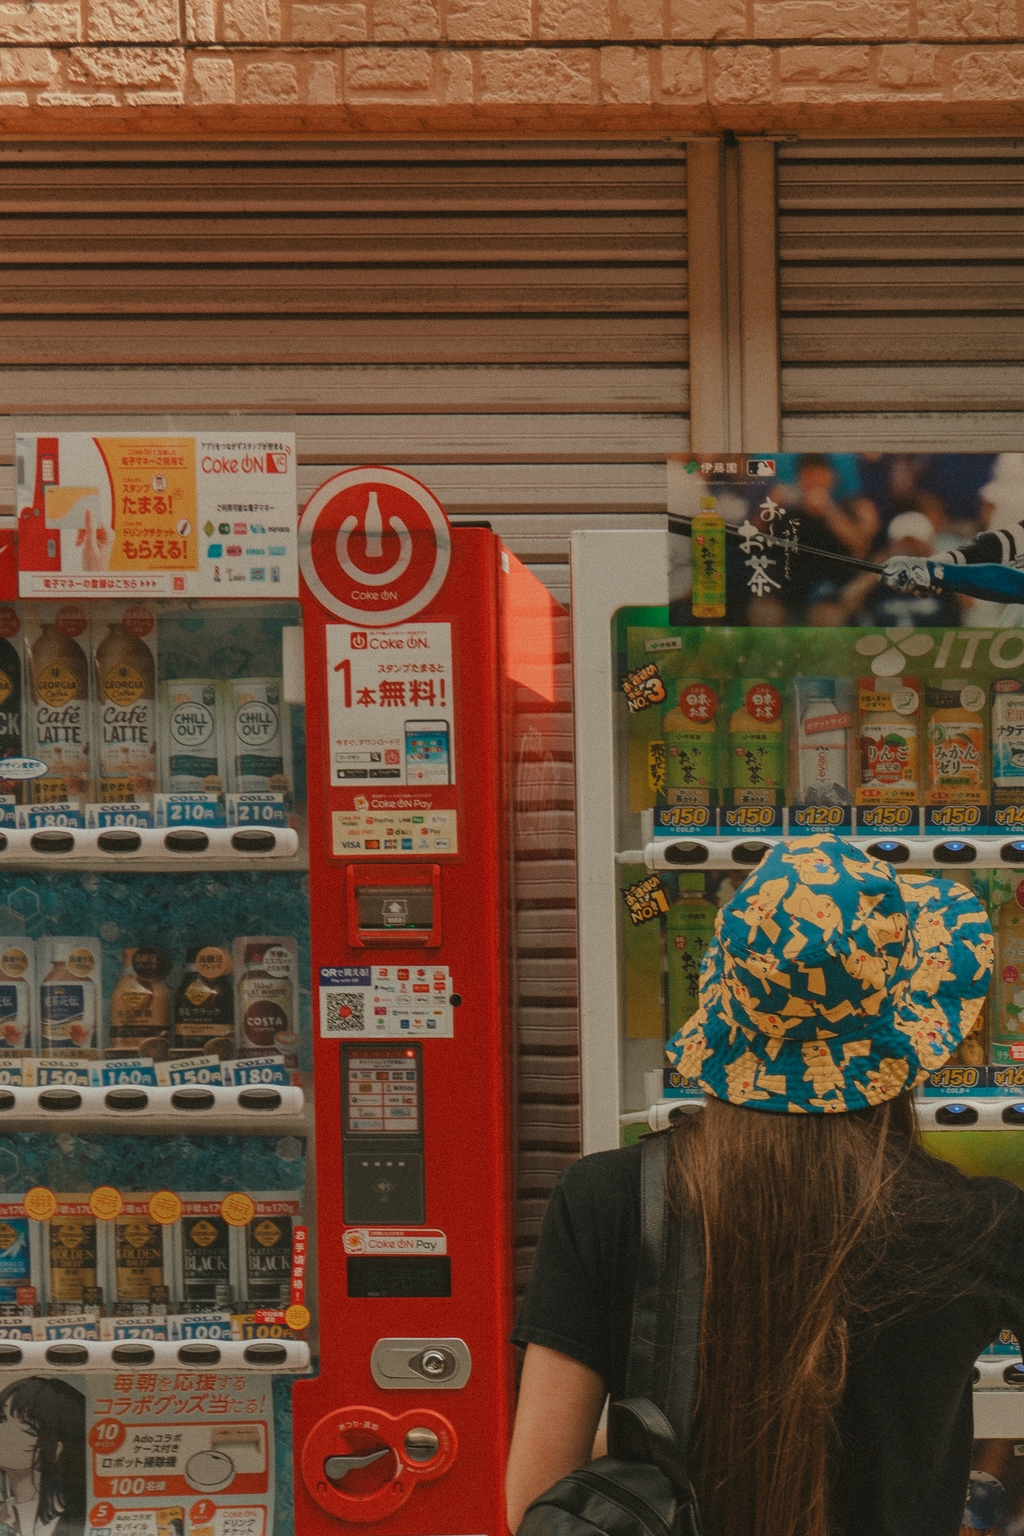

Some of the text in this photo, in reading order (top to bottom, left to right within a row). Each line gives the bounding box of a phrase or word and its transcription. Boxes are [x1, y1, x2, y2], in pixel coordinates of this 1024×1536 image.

[201, 453, 264, 474] Coke ON
[701, 463, 737, 474] 伊藤園
[351, 590, 397, 600] Coke ON
[38, 681, 77, 690] GEORGIA
[104, 681, 144, 690] GEORGIA
[36, 706, 80, 724] Café
[103, 706, 147, 723] Café
[174, 713, 208, 725] CHILL
[239, 713, 273, 725] CHILL
[36, 726, 81, 743] LATTE
[103, 725, 148, 743] LATTE
[178, 724, 203, 736] OUT
[242, 724, 269, 735] OUT
[868, 745, 910, 761] りんご
[934, 745, 978, 760] みかん
[817, 752, 826, 777] evian
[938, 761, 975, 775] ゼリー
[168, 794, 208, 802] COLD
[237, 794, 277, 802] COLD
[371, 800, 397, 808] Coke
[414, 800, 432, 810] Pay
[31, 804, 70, 813] COLD
[101, 804, 140, 812] COLD
[170, 805, 213, 819] 210円
[239, 805, 282, 819] 210円
[660, 808, 708, 825] ¥150
[727, 808, 774, 825] ¥150
[796, 808, 843, 825] ¥120
[864, 807, 911, 824] ¥150
[932, 807, 979, 824] ¥150
[247, 1017, 282, 1026] COSTA
[171, 1059, 210, 1069] COLD
[236, 1059, 274, 1067] COLD
[40, 1070, 88, 1085] 150円
[109, 1070, 151, 1084] 160円
[173, 1070, 220, 1084] 150円
[240, 1068, 282, 1084] 180円
[930, 1069, 977, 1086] ¥150
[368, 1239, 395, 1249] Coke
[416, 1240, 437, 1252] Pay
[185, 1256, 227, 1270] BLACK
[250, 1256, 290, 1270] BLACK
[183, 1325, 231, 1338] 100円
[246, 1326, 293, 1338] 100円
[114, 1374, 246, 1393] 毎朝を応援する
[93, 1395, 266, 1415] コラボグッズ当たる!
[96, 1424, 119, 1441] 10
